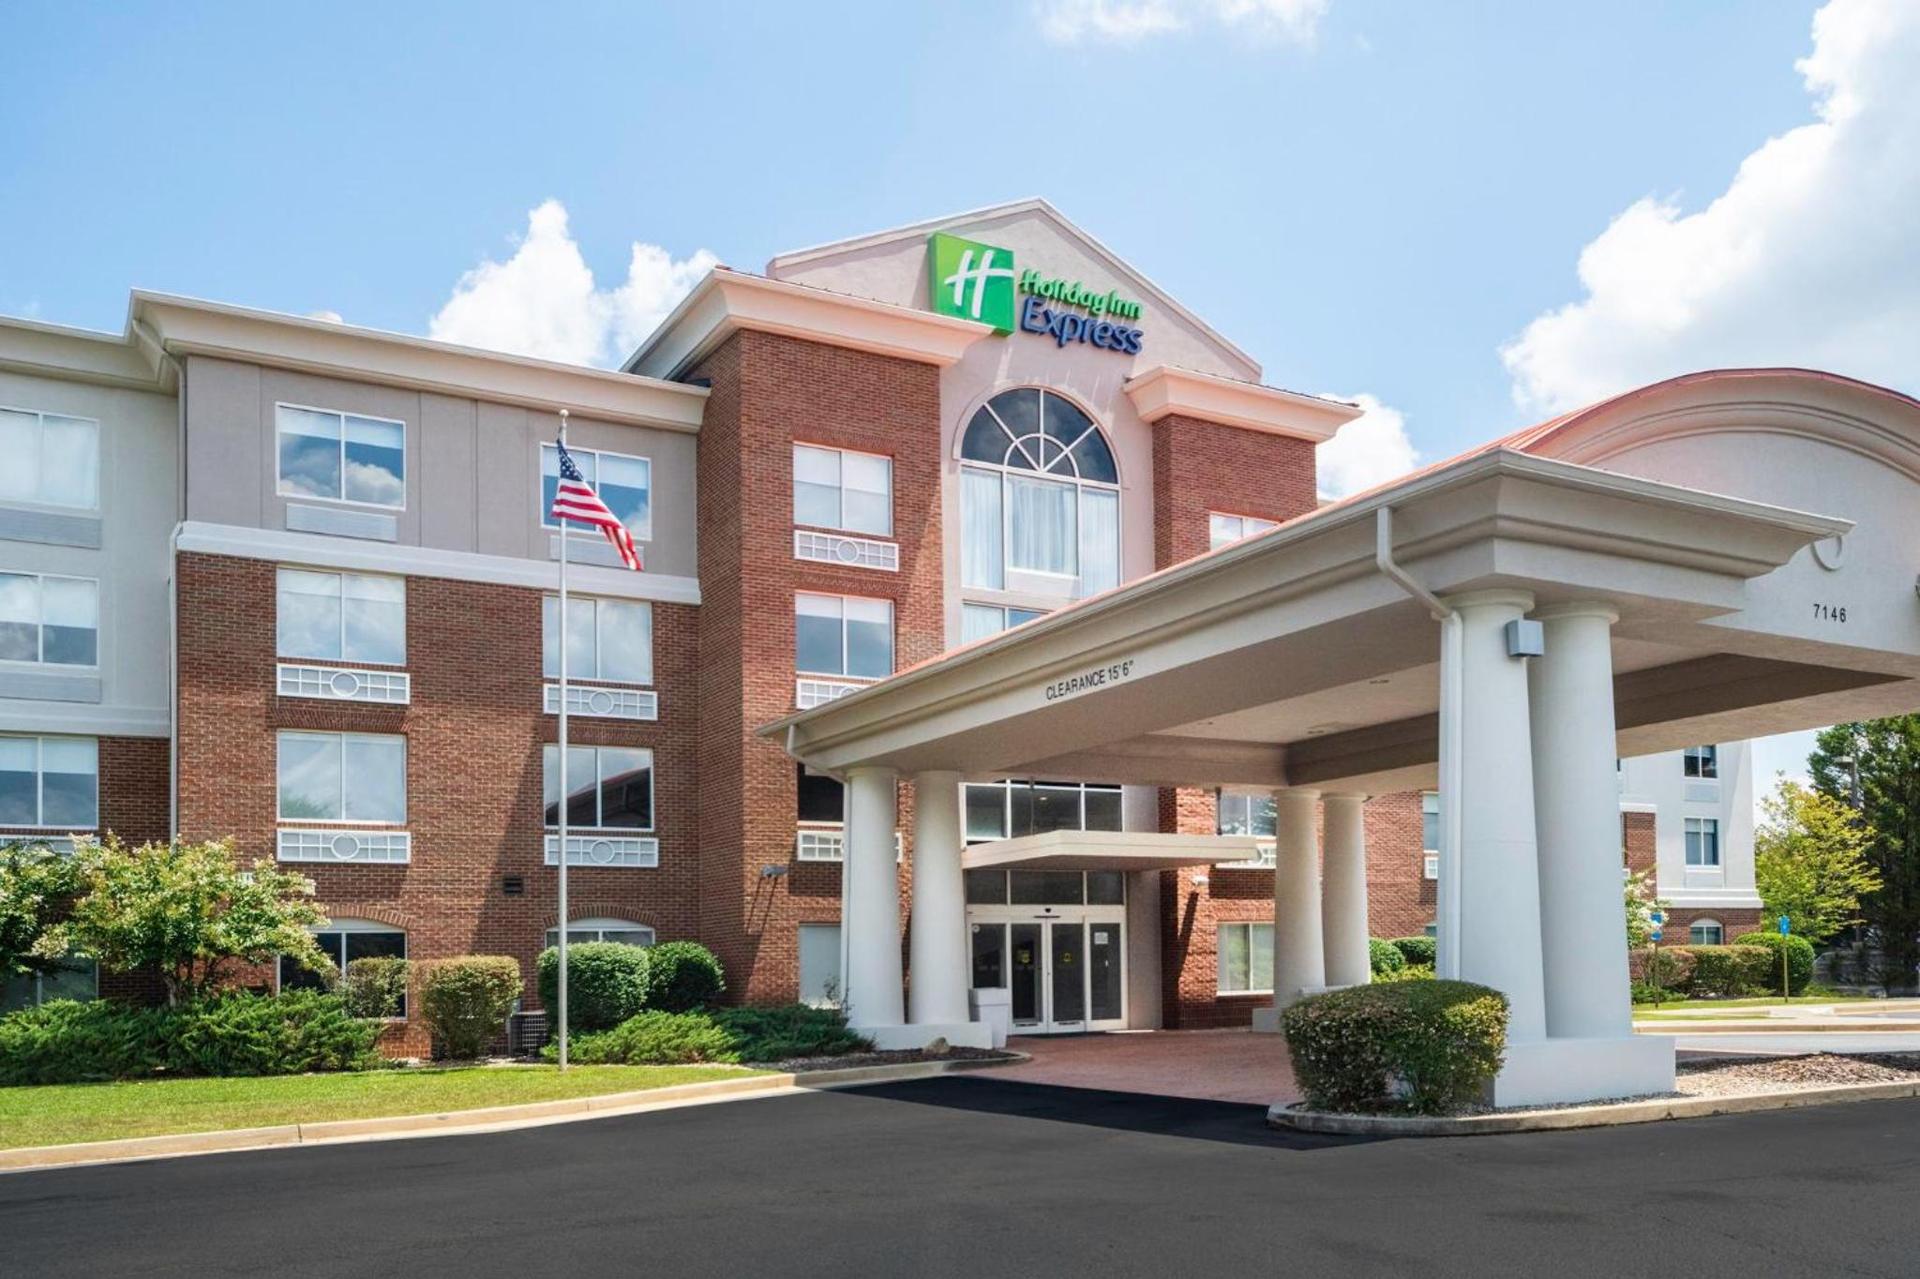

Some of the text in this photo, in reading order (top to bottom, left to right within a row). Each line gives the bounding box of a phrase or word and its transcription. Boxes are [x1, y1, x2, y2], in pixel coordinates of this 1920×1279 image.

[1018, 268, 1144, 319] Holiday Inn
[1021, 296, 1144, 355] Express
[1813, 603, 1847, 623] 7146
[1046, 669, 1106, 700] CLEARANCE
